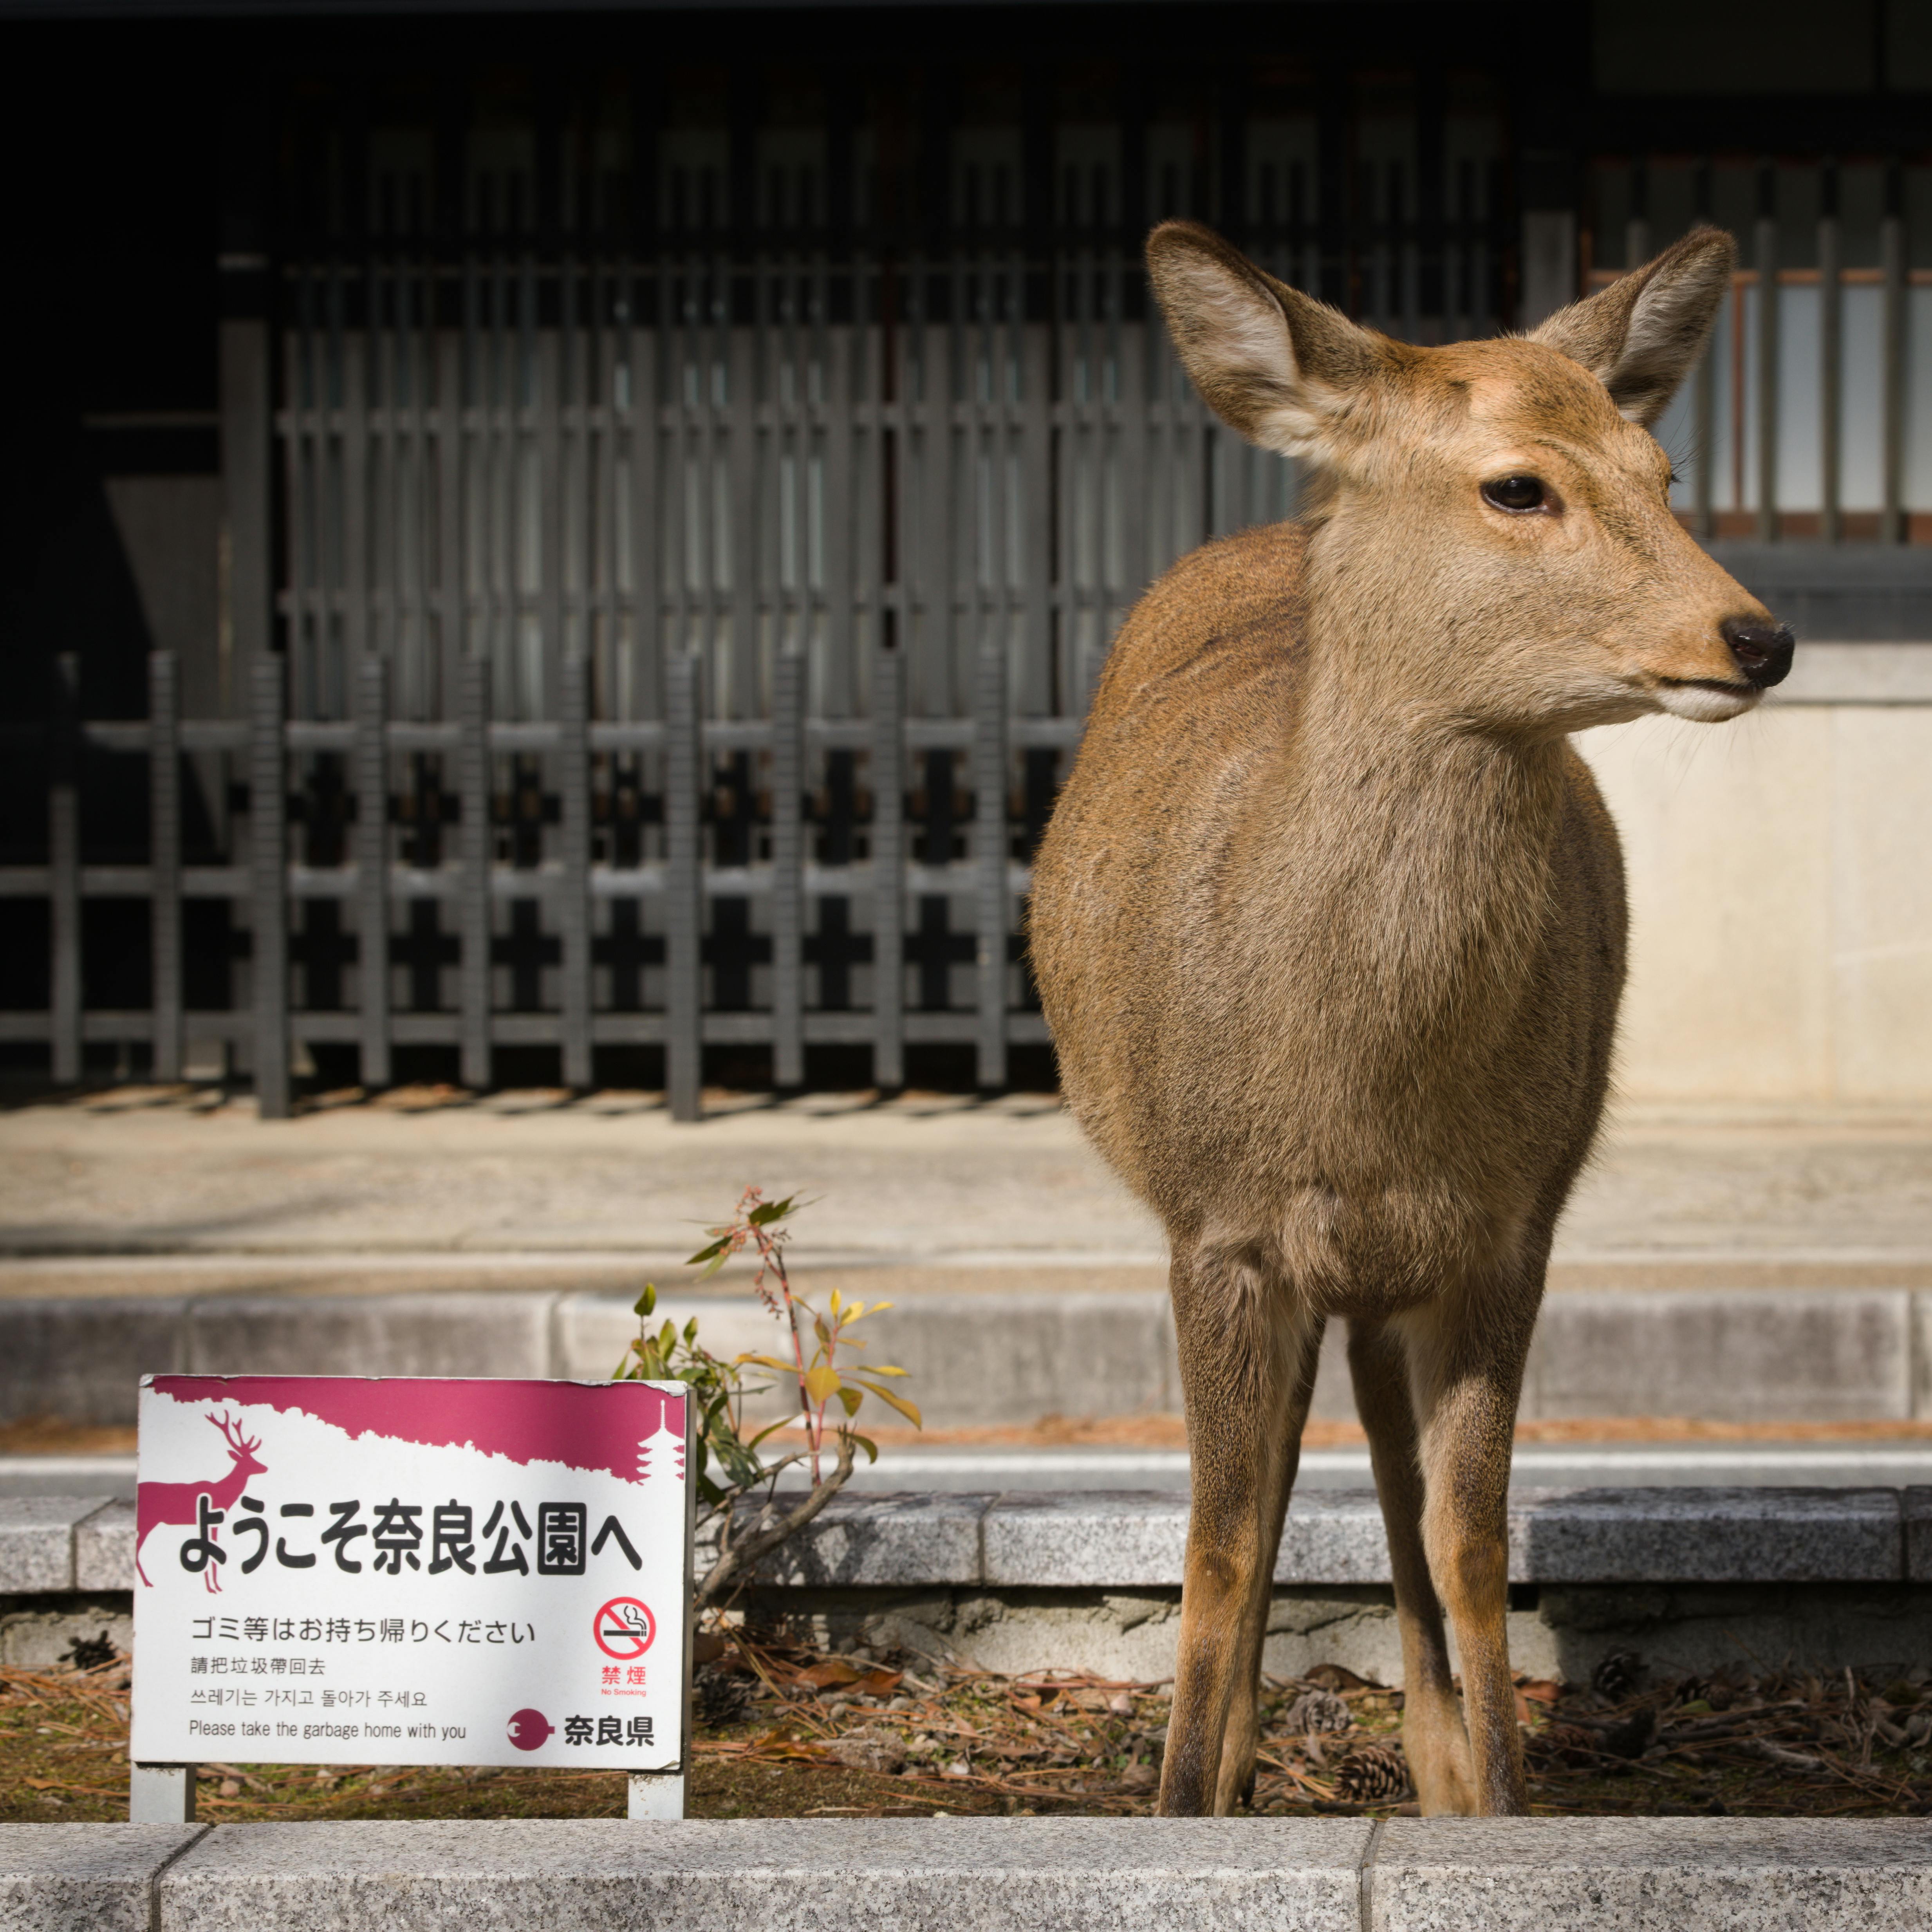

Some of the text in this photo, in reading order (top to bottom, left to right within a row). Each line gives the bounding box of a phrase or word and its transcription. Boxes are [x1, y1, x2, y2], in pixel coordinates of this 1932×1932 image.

[181, 1496, 642, 1576] ようこそ奈良公園へ
[193, 1616, 535, 1644] ゴミ等はお持ち帰りください
[191, 1657, 325, 1675] 請把垃圾帶回去
[602, 1666, 646, 1685] 禁煙
[191, 1688, 427, 1708] 쓰레기는 가지고 돌아가 주세요
[614, 1688, 646, 1697] Smoking
[190, 1720, 466, 1741] Please take the garbage home with you
[564, 1714, 654, 1747] 奈良県
